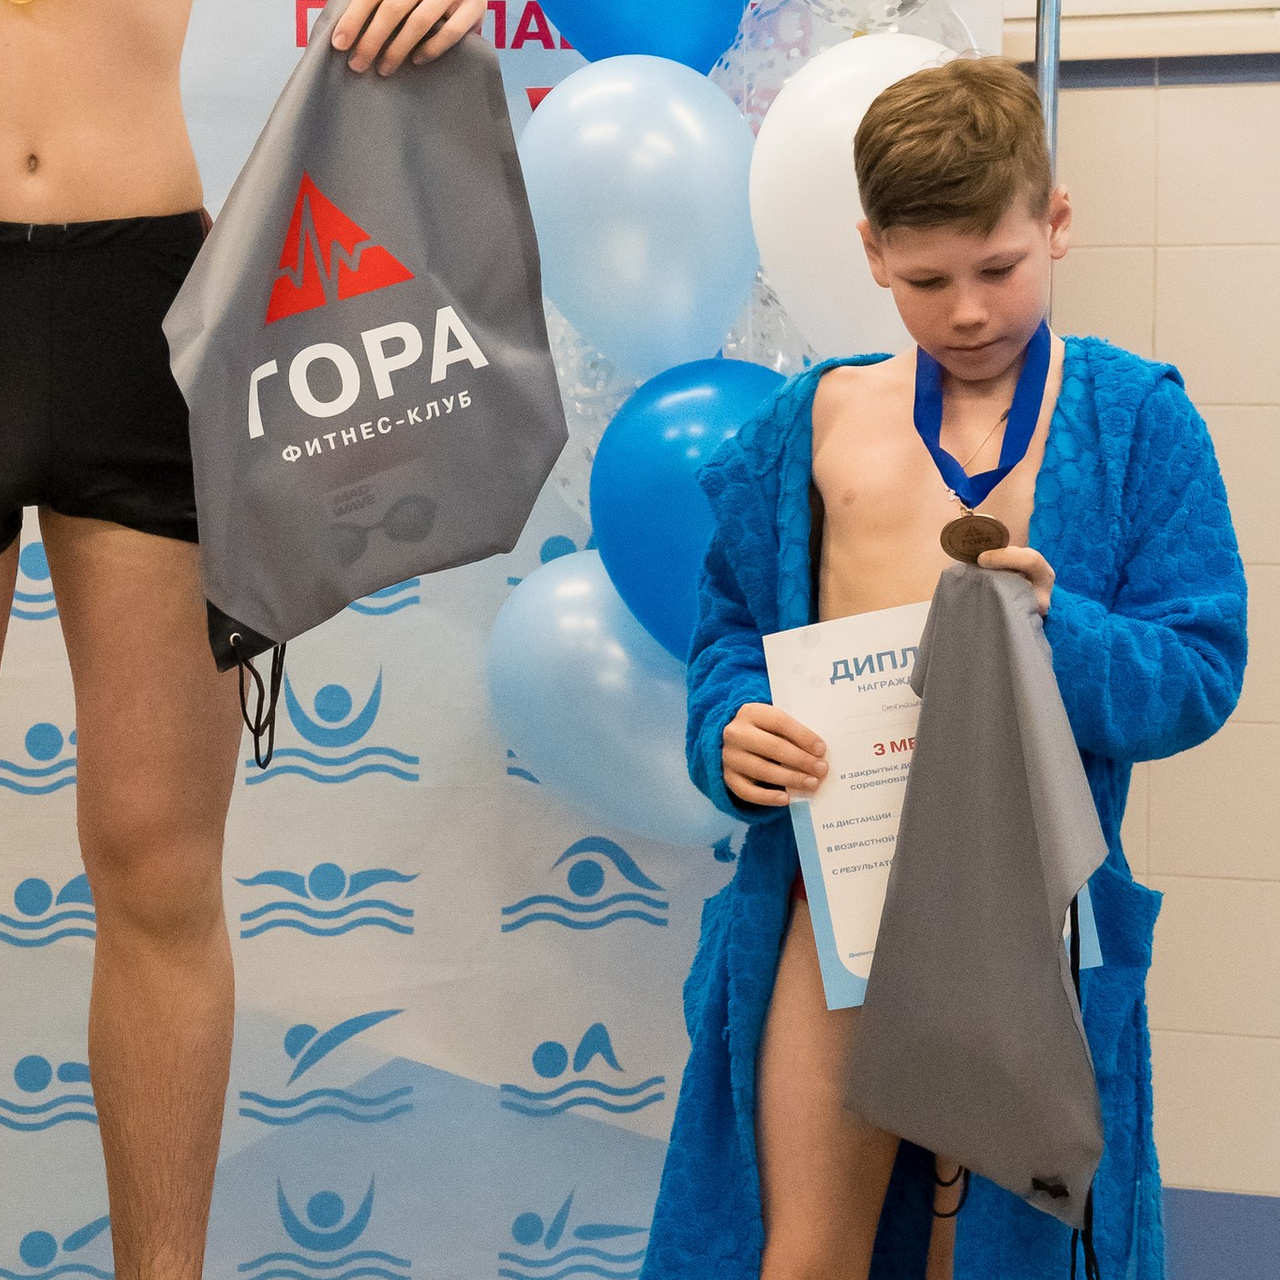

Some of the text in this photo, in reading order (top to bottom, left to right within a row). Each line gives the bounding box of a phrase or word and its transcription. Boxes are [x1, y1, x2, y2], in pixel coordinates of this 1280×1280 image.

[247, 306, 490, 440] ГОРА
[281, 390, 473, 463] ФИТНЕС-КЛУБ
[829, 646, 921, 685] ДИПЛ
[858, 676, 911, 693] НАГРАЖ
[873, 743, 886, 756] 3
[848, 764, 900, 779] закрытых
[850, 775, 908, 791] соревнова
[822, 812, 892, 830] НА ДИСТАНЦИИ
[834, 835, 895, 851] ВОЗРАСТНОЙ
[840, 860, 893, 874] РЕЗУЛЬТАТ
